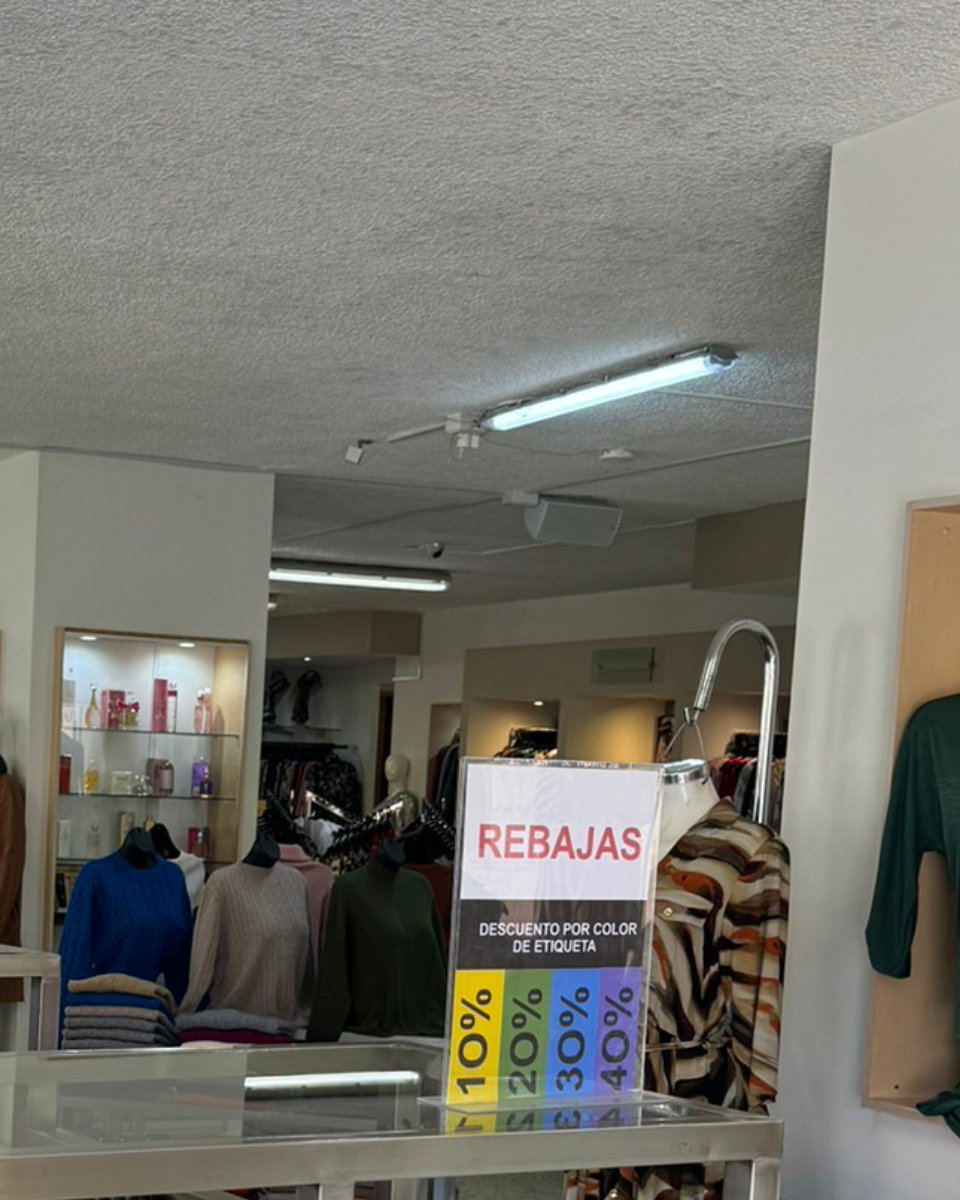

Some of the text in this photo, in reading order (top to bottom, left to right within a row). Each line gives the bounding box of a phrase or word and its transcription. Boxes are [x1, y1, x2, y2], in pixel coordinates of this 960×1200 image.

[477, 823, 641, 862] REBAJAS
[479, 922, 638, 936] DESCUENTO POR COLOR
[513, 939, 596, 954] DE ETIQUETA
[456, 988, 492, 1095] 10%
[508, 988, 543, 1095] 20%
[555, 986, 590, 1092] 30%
[600, 987, 634, 1091] 40%
